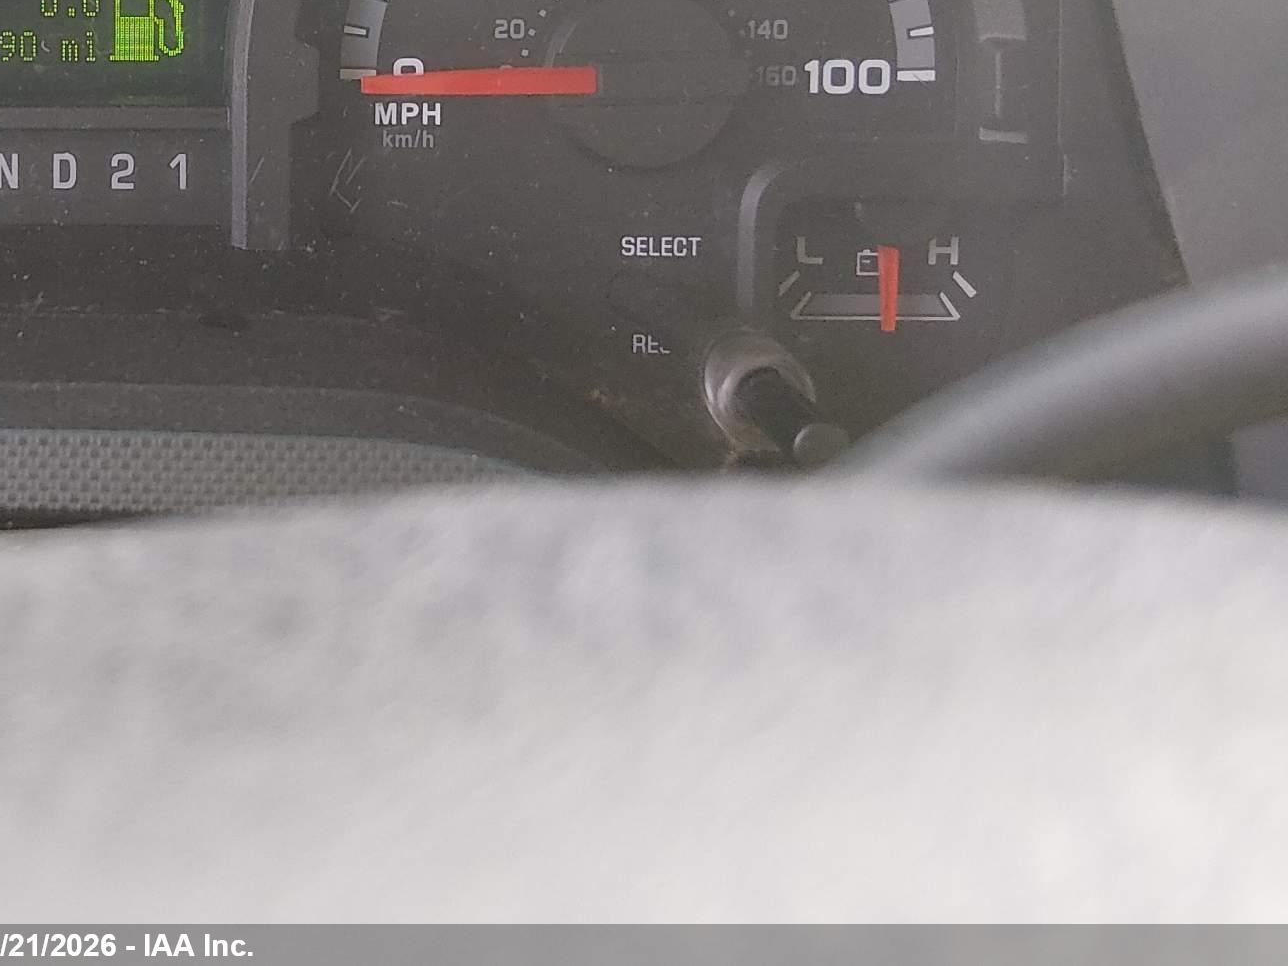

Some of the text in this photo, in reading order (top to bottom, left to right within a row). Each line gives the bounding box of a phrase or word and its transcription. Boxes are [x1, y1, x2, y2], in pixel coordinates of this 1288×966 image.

[494, 18, 525, 39] 20
[748, 19, 789, 40] 140
[62, 31, 96, 62] mi
[804, 59, 891, 95] 100
[374, 102, 441, 126] MPH
[382, 129, 435, 149] km/h
[52, 152, 77, 189] D
[111, 153, 135, 190] 2
[169, 153, 187, 190] 1
[621, 236, 702, 257] SELECT
[796, 236, 824, 265] L
[927, 237, 959, 266] H
